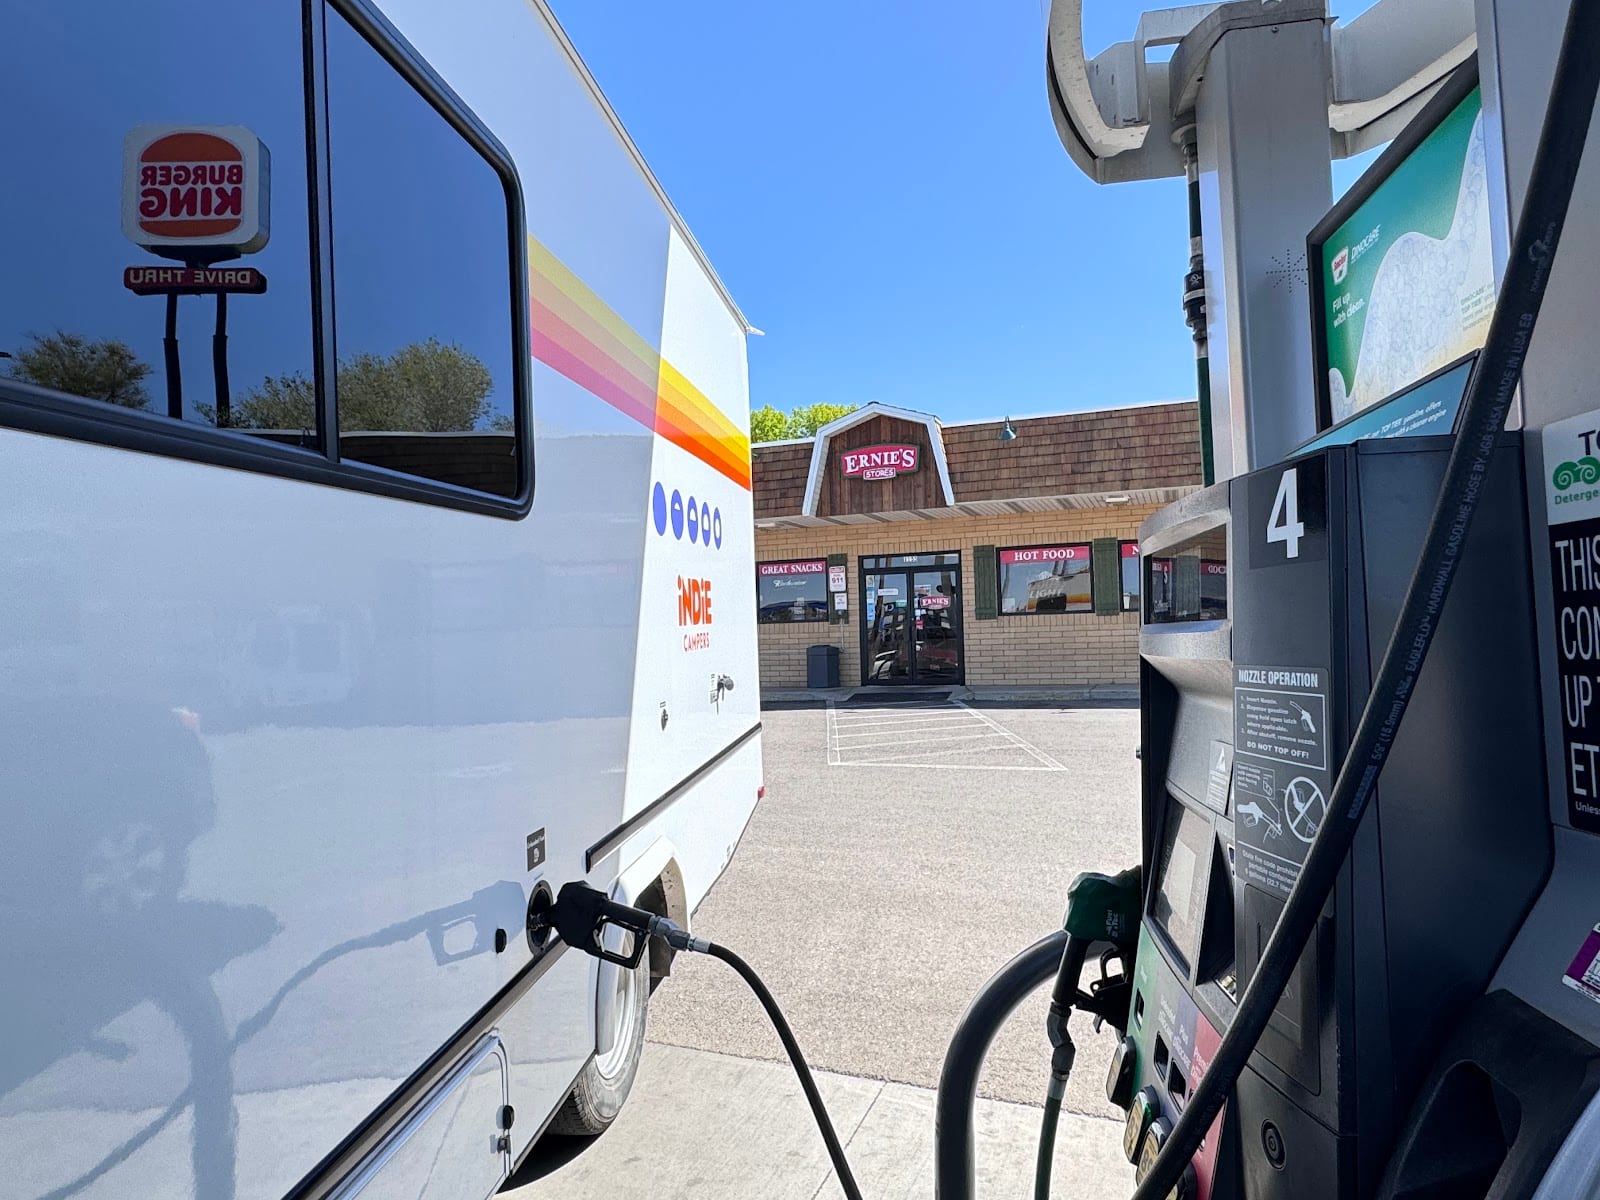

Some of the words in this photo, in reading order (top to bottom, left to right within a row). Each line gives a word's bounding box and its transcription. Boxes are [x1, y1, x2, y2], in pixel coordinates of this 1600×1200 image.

[1511, 330, 1528, 355] USA
[1506, 356, 1520, 369] IN
[1497, 370, 1515, 402] MADE
[1479, 434, 1494, 456] JGB
[844, 448, 915, 473] ERNIE'S
[1472, 457, 1487, 472] BY
[865, 469, 894, 478] STORES
[1462, 472, 1482, 504] HOSE
[1266, 468, 1304, 558] 4
[1446, 503, 1472, 555] GASOLINE
[1014, 551, 1039, 561] HOT
[1043, 549, 1075, 560] FOOD
[762, 564, 788, 575] GREAT
[791, 563, 822, 573] SNACKS
[1427, 557, 1454, 614] HARDWALL
[922, 597, 949, 607] ERNIE'S
[683, 632, 710, 652] CAMPERS
[1238, 669, 1266, 684] NOZZLE
[1268, 671, 1318, 688] OPERATION
[1564, 675, 1592, 728] UP
[1247, 741, 1256, 749] DO
[1258, 742, 1272, 751] NOT
[1274, 745, 1289, 755] TOP
[1291, 748, 1309, 759] OFF!
